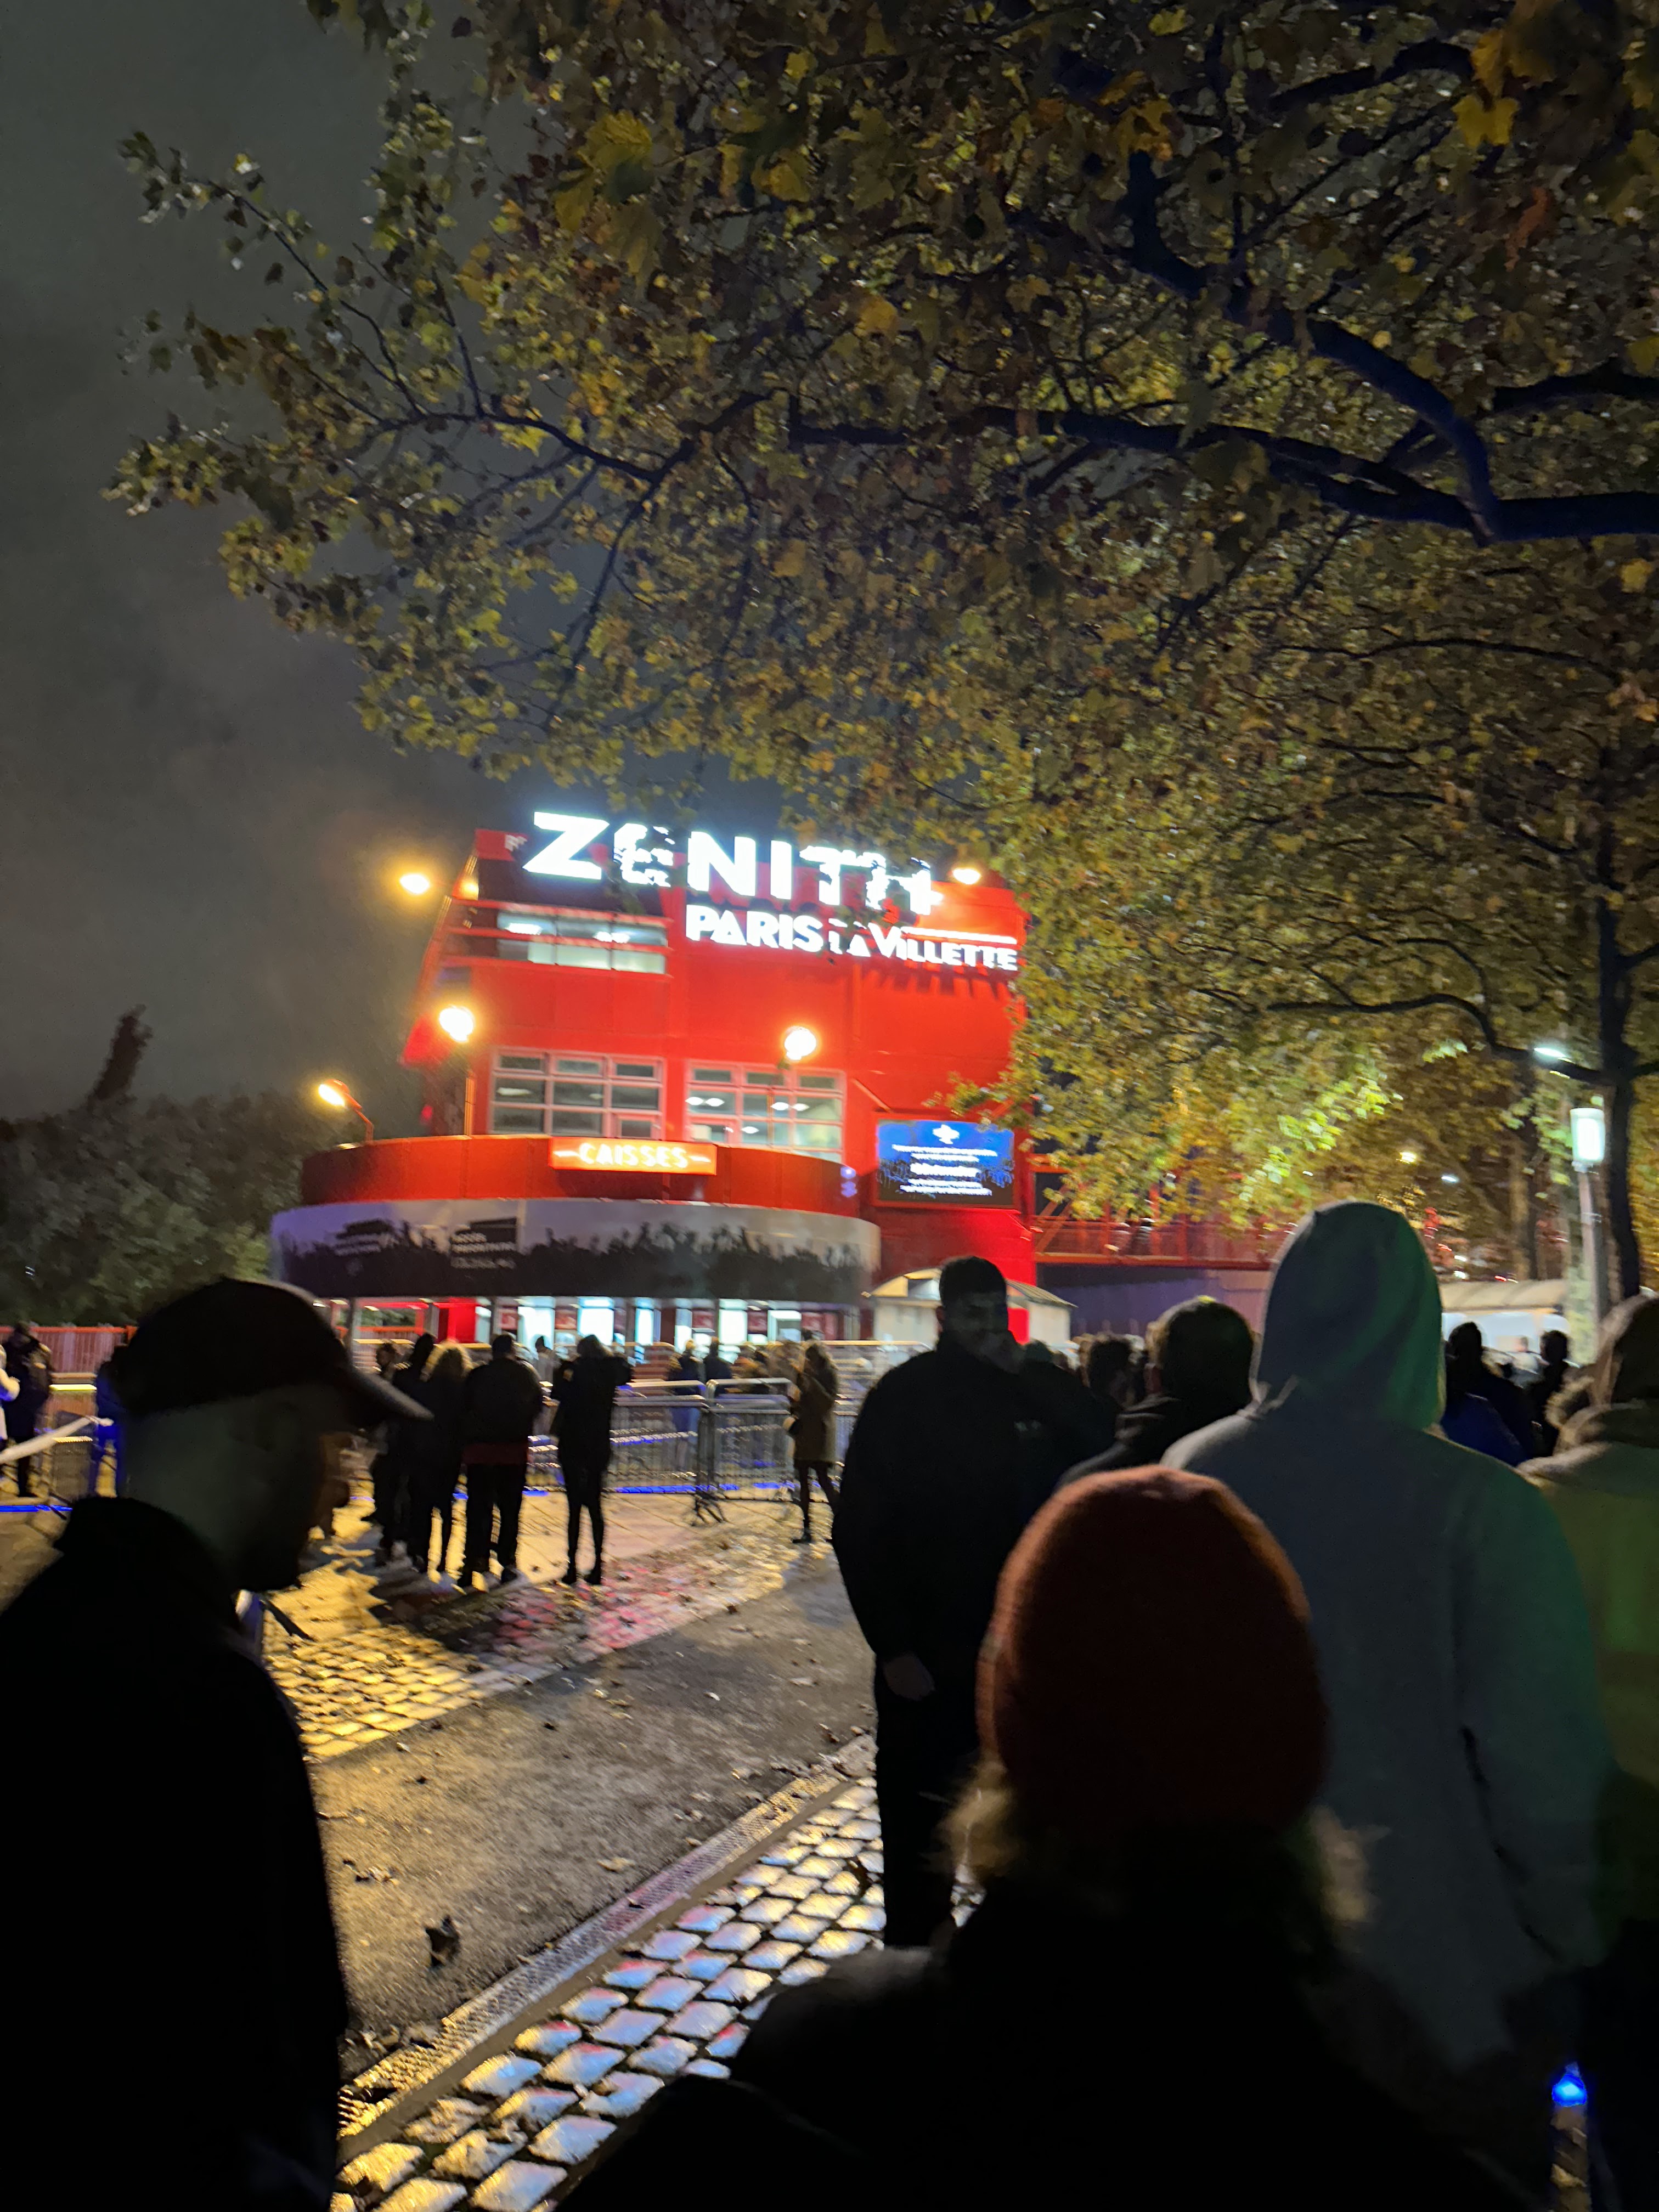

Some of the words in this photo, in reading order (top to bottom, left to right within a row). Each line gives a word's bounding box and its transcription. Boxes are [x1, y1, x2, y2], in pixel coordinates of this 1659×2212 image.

[685, 904, 824, 952] PARIS
[867, 922, 1018, 971] VILLETTE
[578, 1142, 689, 1169] CAISSES
